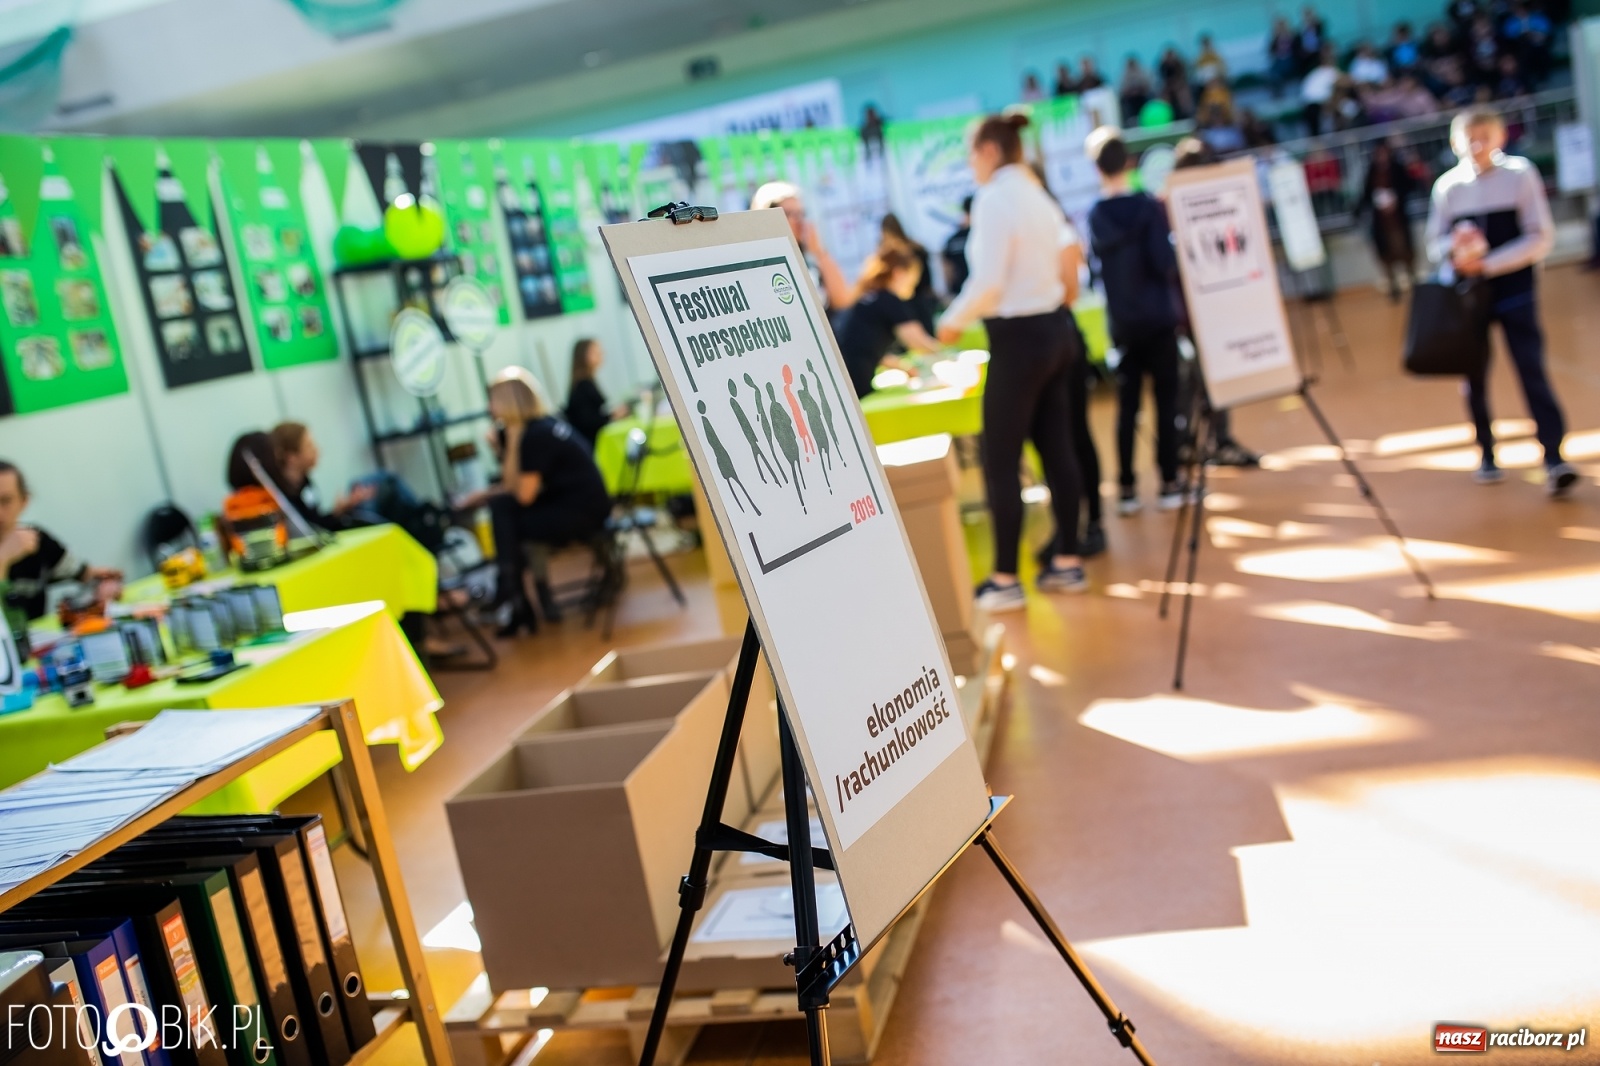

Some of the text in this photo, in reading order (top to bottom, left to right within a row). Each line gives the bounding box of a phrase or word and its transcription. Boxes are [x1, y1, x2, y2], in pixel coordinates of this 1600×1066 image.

[668, 280, 750, 324] Festiwal
[686, 315, 792, 367] perspektyw
[850, 495, 876, 524] 2019
[866, 666, 941, 738] ekonomia
[835, 691, 950, 813] /rachunkowość
